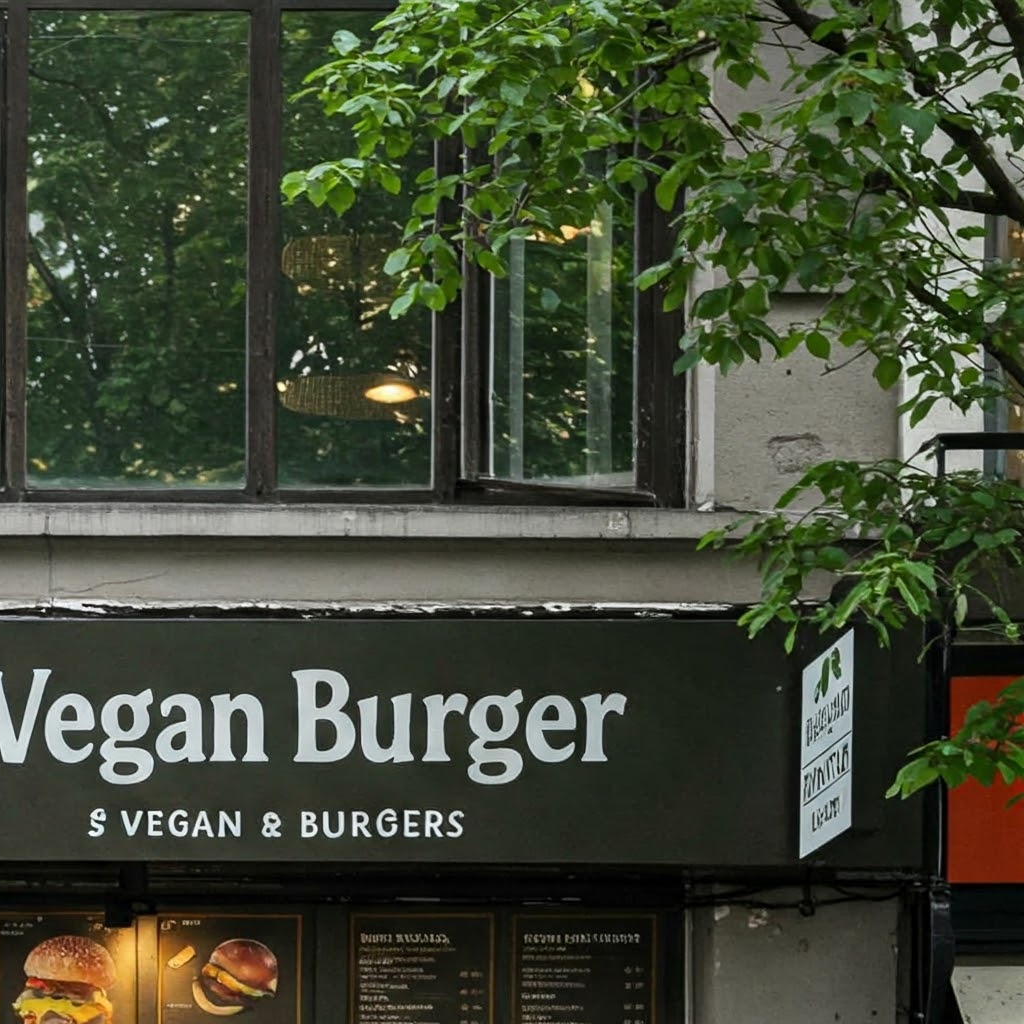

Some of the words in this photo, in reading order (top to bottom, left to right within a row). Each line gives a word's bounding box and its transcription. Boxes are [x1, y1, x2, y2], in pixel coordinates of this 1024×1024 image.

[291, 668, 628, 785] Burger
[120, 808, 242, 838] VEGAN
[260, 811, 282, 839] &
[300, 807, 465, 839] BURGERS
